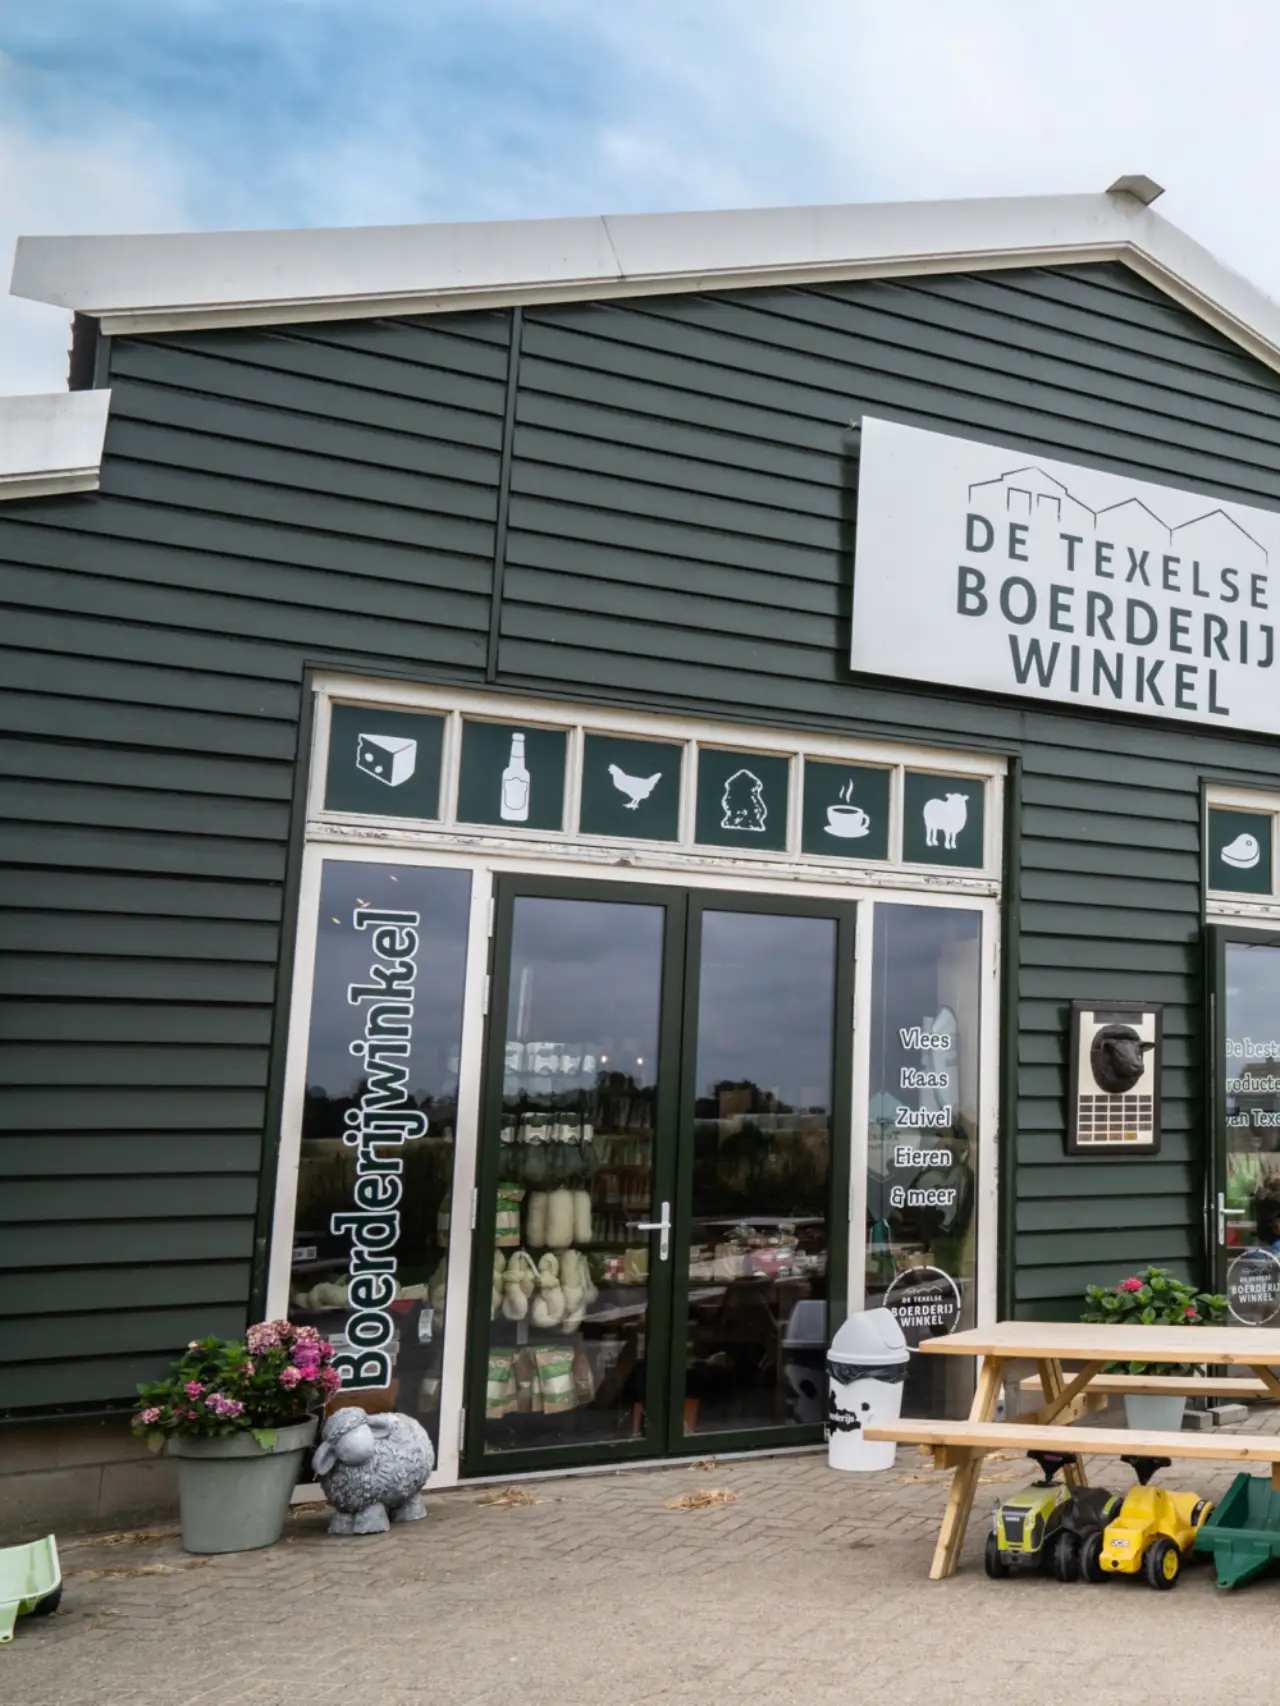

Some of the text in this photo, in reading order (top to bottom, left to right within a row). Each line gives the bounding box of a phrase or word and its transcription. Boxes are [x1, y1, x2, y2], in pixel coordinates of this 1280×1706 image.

[966, 513, 1269, 610] DE TEXELSE
[956, 565, 1275, 669] BOERDERIJ
[1008, 634, 1230, 716] WINKEL
[900, 1026, 951, 1050] Vlees
[900, 1067, 949, 1088] Kaas
[895, 1105, 952, 1128] Zuivel
[330, 908, 429, 1391] Boerderijwinkel
[894, 1147, 952, 1168] Eieren
[890, 1185, 956, 1208] & meer
[1239, 1292, 1273, 1303] WINKEL
[891, 1304, 953, 1317] BOERDERIJ
[900, 1315, 944, 1327] WINKEL
